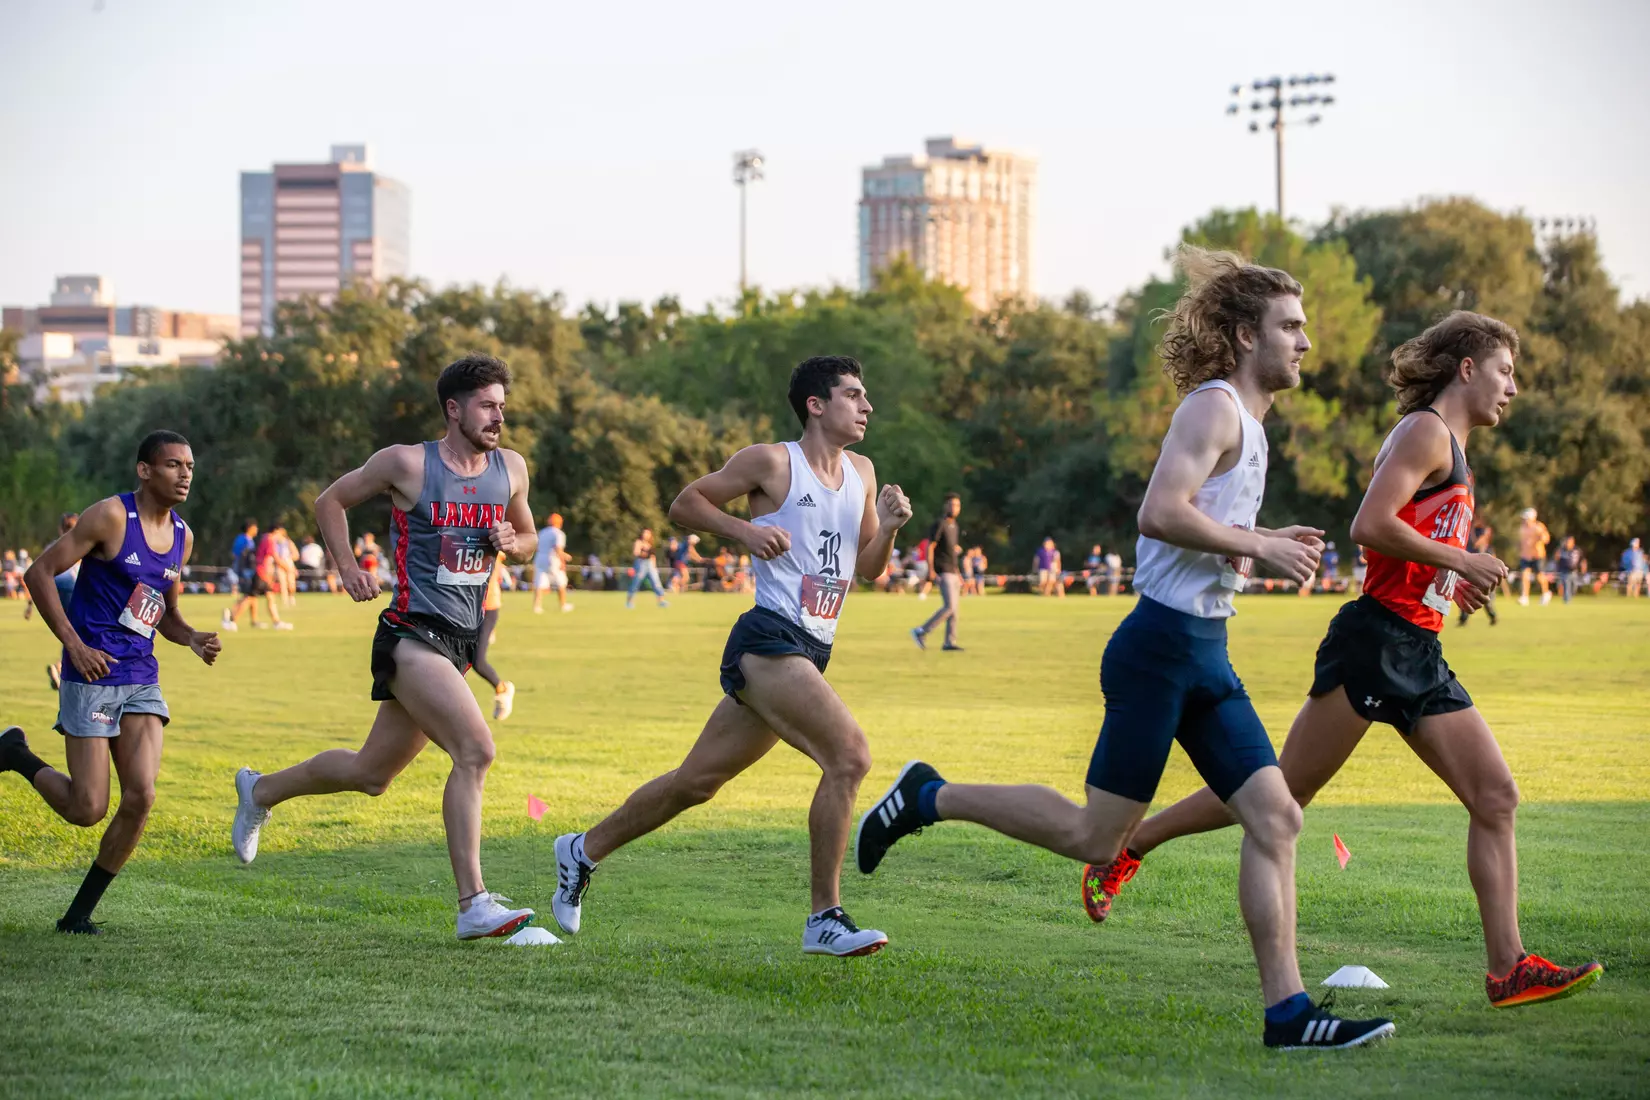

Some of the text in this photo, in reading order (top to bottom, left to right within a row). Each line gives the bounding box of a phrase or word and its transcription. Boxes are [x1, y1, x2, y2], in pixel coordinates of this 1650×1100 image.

[456, 549, 484, 571] 158
[138, 598, 159, 623] 163
[815, 590, 839, 616] 167
